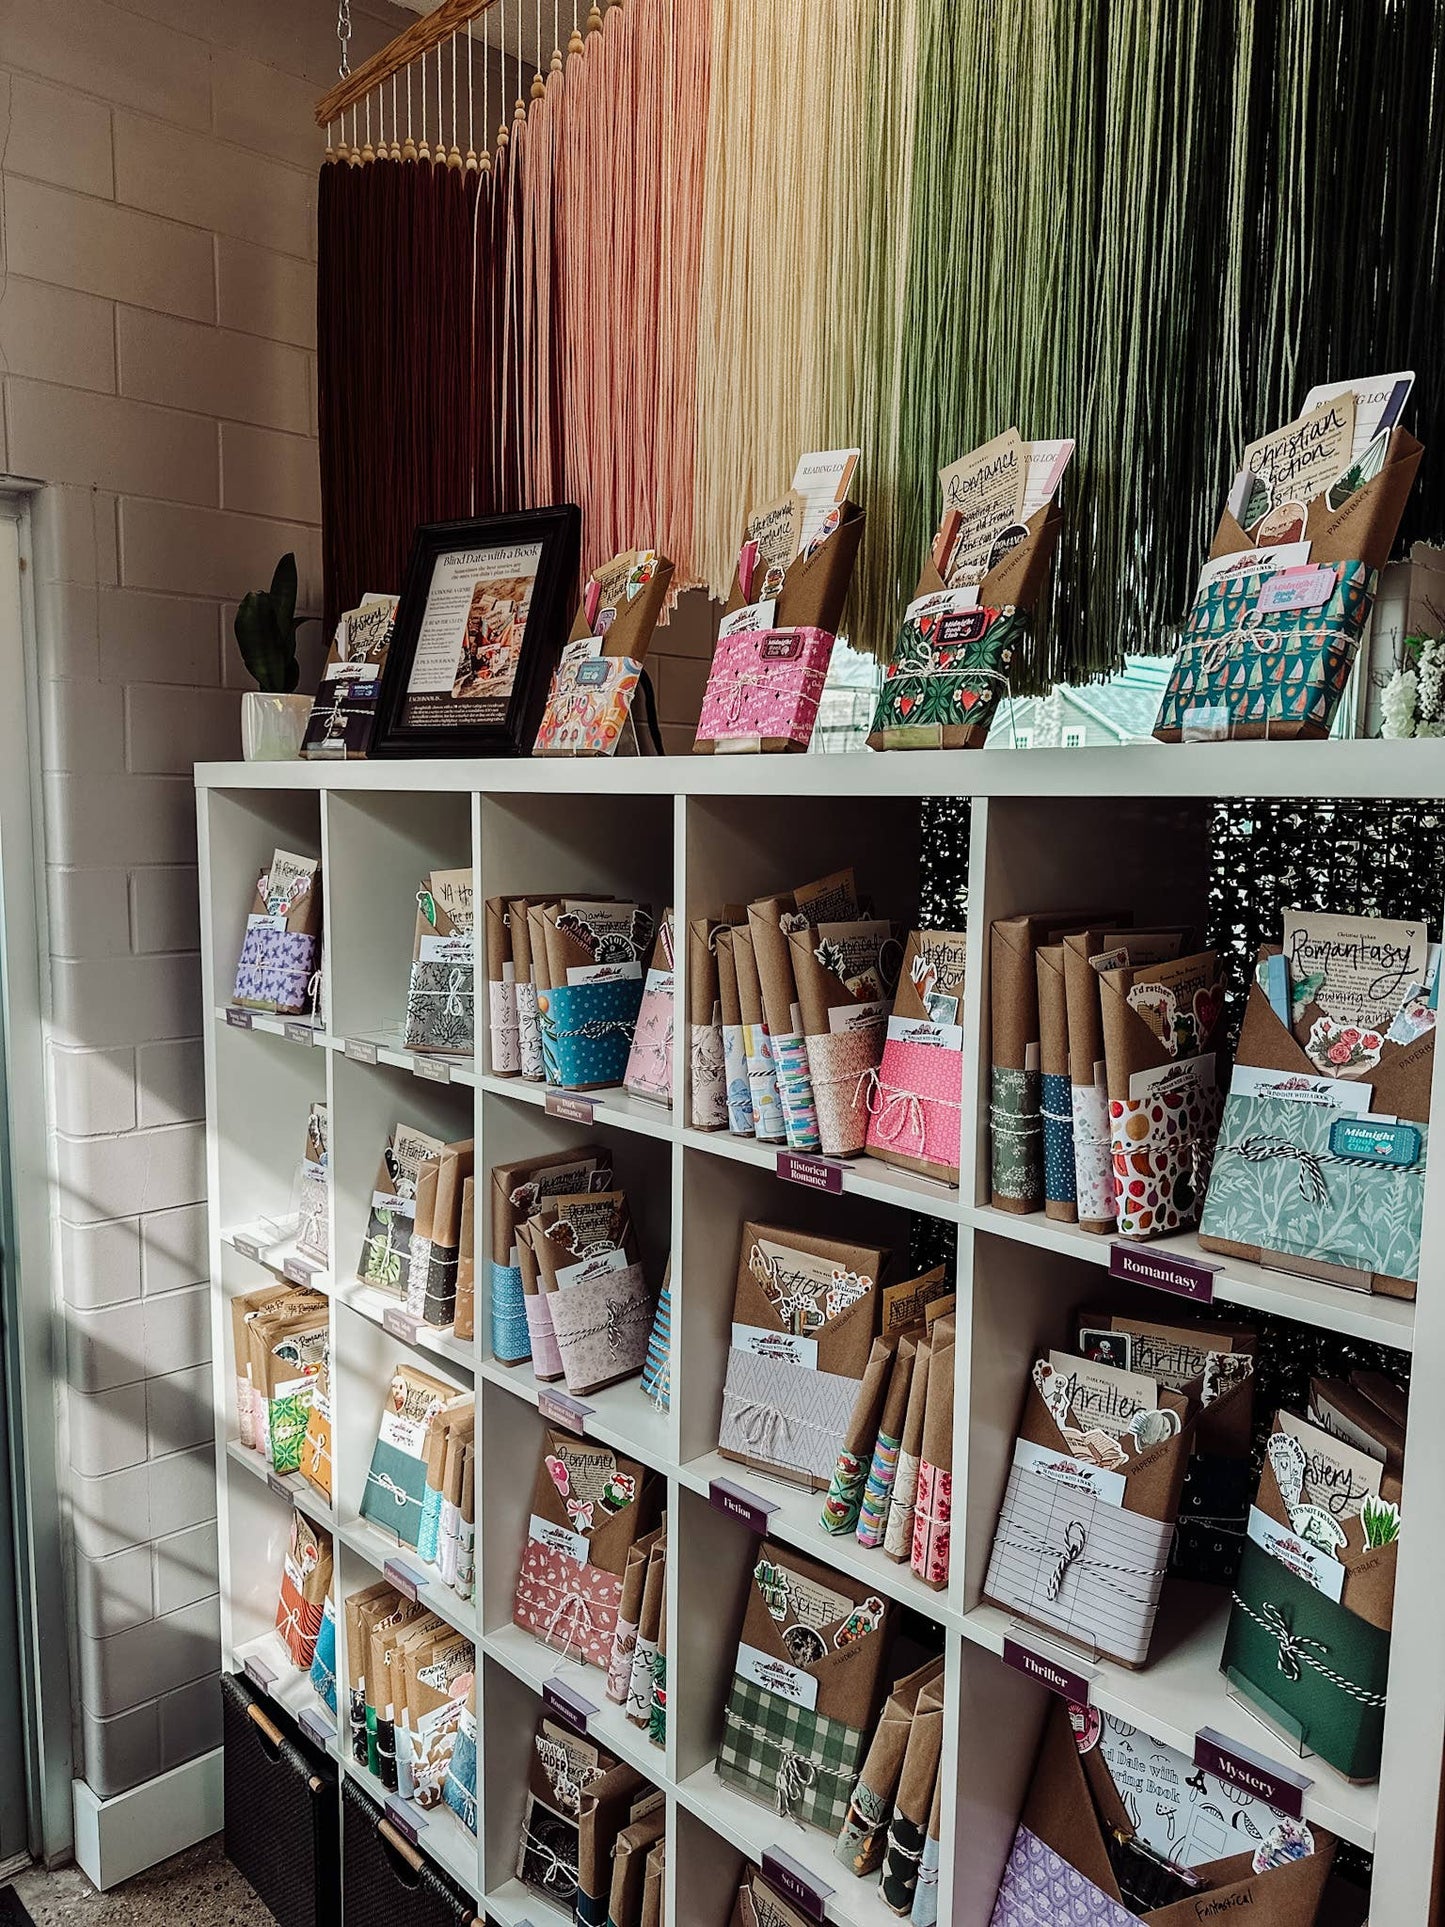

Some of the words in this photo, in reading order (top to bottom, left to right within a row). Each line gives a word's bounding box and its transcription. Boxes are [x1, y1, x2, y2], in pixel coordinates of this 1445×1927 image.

[1250, 408, 1347, 474] Christian
[803, 464, 832, 476] READING
[948, 450, 1018, 504] Romance
[1327, 489, 1373, 535] PAPERBACK
[443, 553, 466, 567] Blind
[466, 551, 487, 564] Date
[488, 549, 506, 561] with
[514, 545, 540, 558] Book
[997, 547, 1033, 582] PAPERBACK
[944, 618, 975, 629] Midnight
[570, 921, 593, 946] DARK
[1290, 928, 1419, 1001] Romantasy
[1133, 986, 1144, 997] I'd
[1145, 985, 1172, 998] rather
[1344, 1127, 1396, 1141] Midnight
[1347, 1143, 1372, 1152] Club
[1348, 1137, 1376, 1146] Book
[790, 1159, 828, 1178] Historical
[791, 1169, 827, 1187] Romance
[1122, 1257, 1199, 1292] Romantasy
[834, 1282, 864, 1297] Welcome
[830, 1309, 857, 1334] HARDBACK
[1130, 1335, 1207, 1375] Thrille
[1066, 1372, 1147, 1419] Thriller
[1131, 1446, 1170, 1476] PAPERBACK
[1273, 1435, 1288, 1445] BOOK
[1293, 1447, 1304, 1464] DAY
[1303, 1452, 1370, 1515] stery
[724, 1497, 751, 1519] Fiction
[1292, 1507, 1304, 1518] IT'S
[1304, 1507, 1317, 1515] NOT
[1317, 1510, 1346, 1545] HOARDING
[1347, 1559, 1380, 1579] PERBACK
[1023, 1654, 1069, 1689] Thriller
[550, 1696, 578, 1722] Romance
[1117, 1751, 1146, 1773] Date
[1149, 1764, 1179, 1785] with
[1218, 1756, 1276, 1798] Mystery
[1109, 1769, 1144, 1793] oring
[1146, 1778, 1181, 1804] Book
[781, 1873, 794, 1889] Sci
[796, 1884, 804, 1898] Fi
[1194, 1890, 1254, 1923] Fantastical
